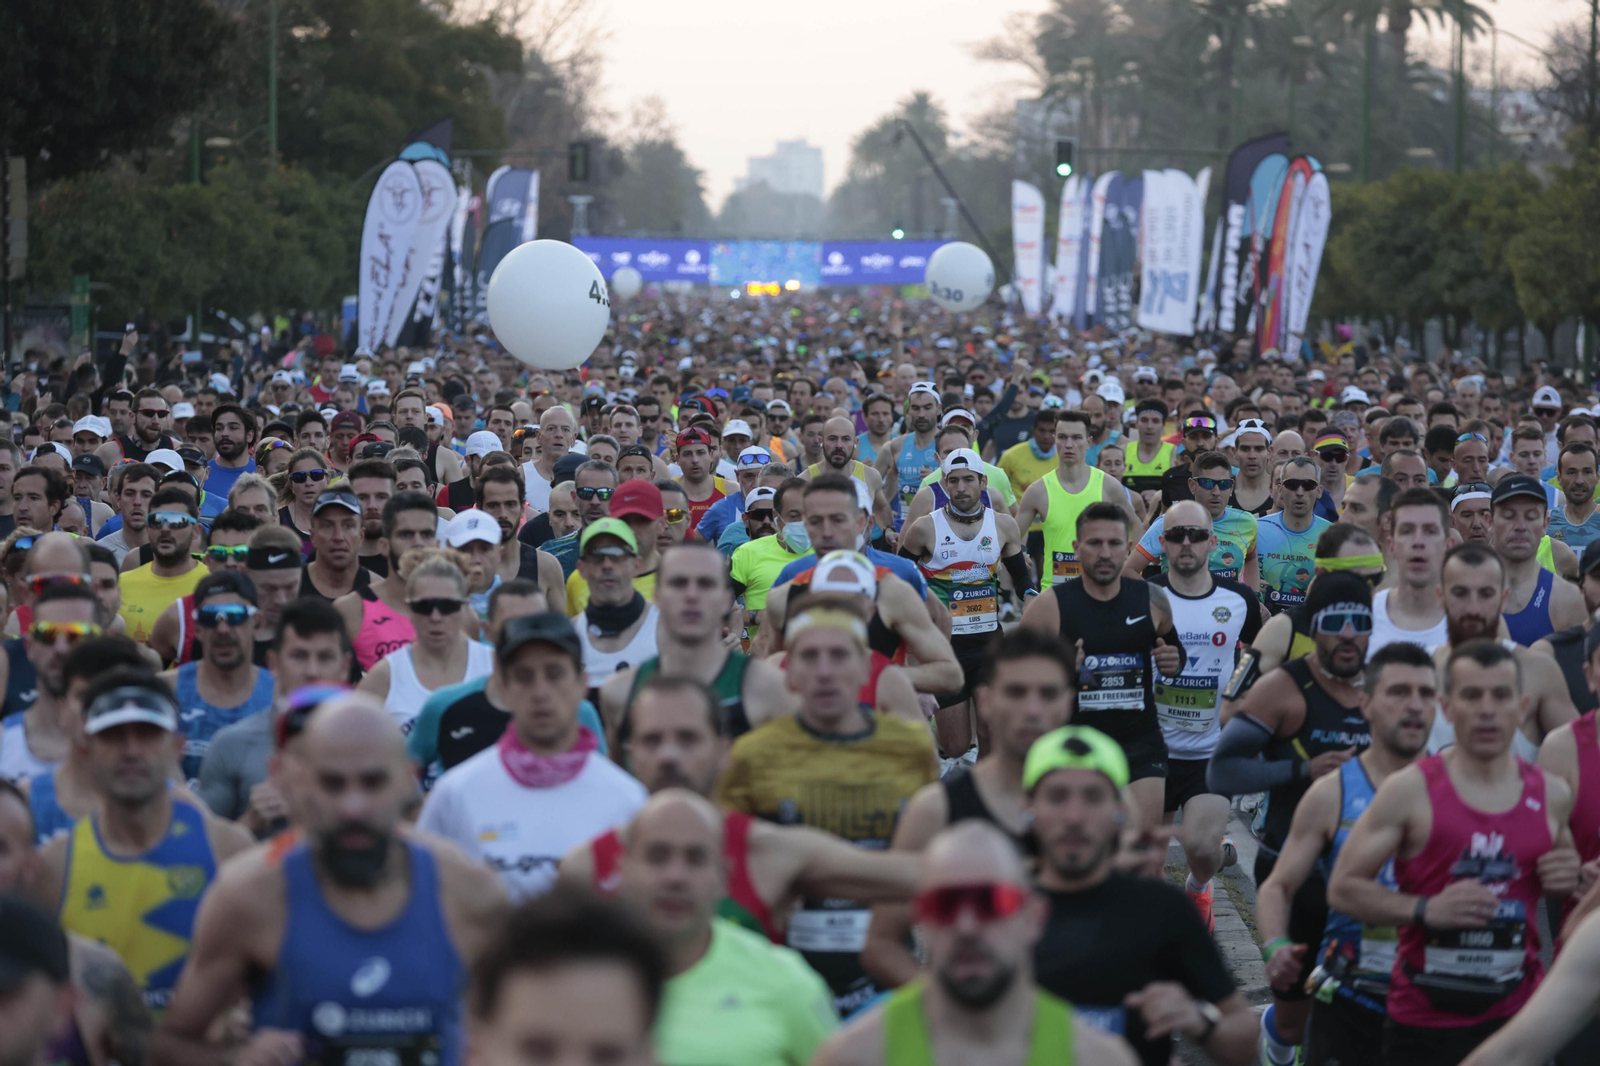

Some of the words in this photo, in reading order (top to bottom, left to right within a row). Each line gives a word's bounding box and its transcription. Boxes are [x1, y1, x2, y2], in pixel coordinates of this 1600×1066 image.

[1267, 552, 1280, 560] POR
[964, 589, 990, 598] ZURICH
[1282, 593, 1307, 603] ZURIC
[1177, 632, 1211, 641] eBank
[1101, 676, 1125, 687] 2853
[1175, 677, 1212, 687] ZURICH
[1081, 693, 1100, 701] MAXI
[1175, 695, 1197, 706] 1113
[1168, 708, 1201, 718] KENNETH
